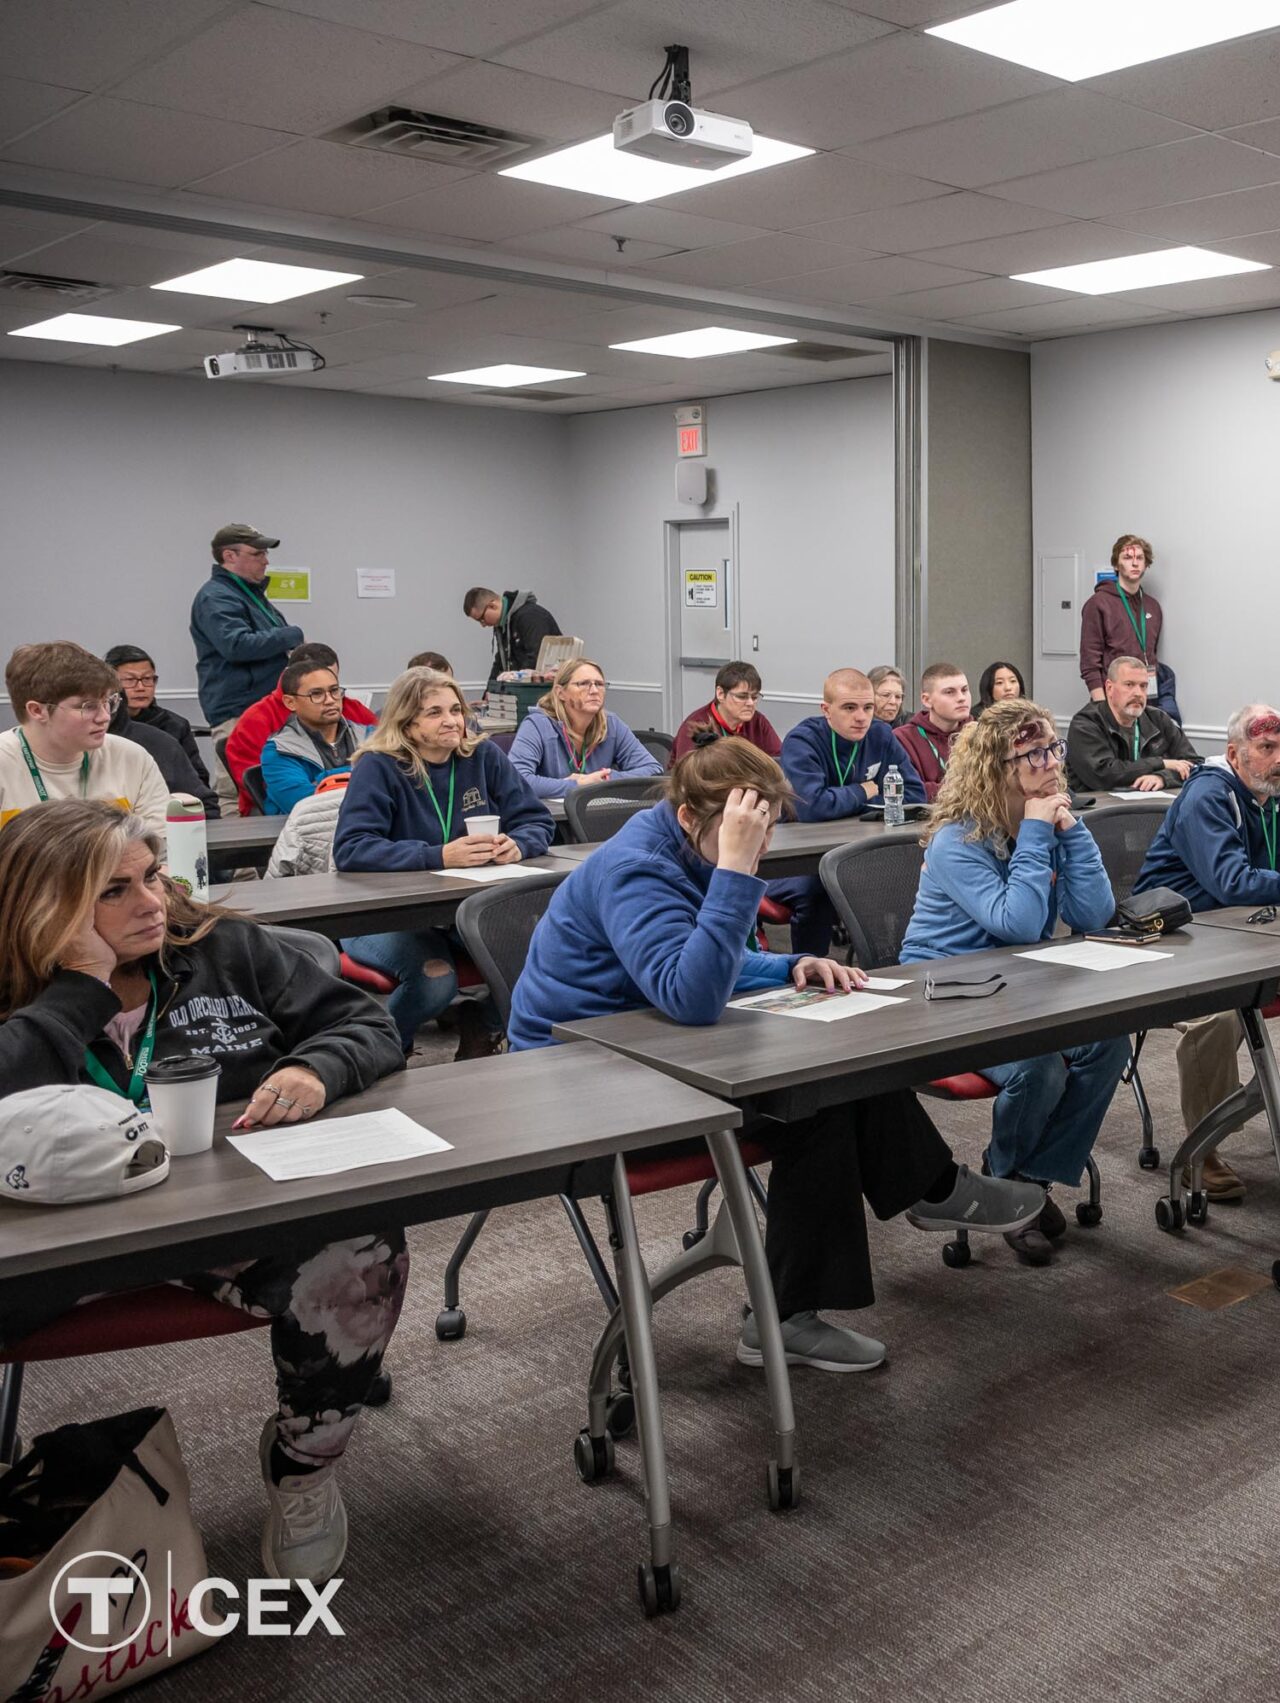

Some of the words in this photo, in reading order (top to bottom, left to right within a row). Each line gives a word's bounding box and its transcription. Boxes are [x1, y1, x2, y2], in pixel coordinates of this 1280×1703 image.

[680, 430, 698, 452] EXIT
[689, 573, 713, 581] CAUTION
[169, 1005, 189, 1027] OLD
[188, 996, 229, 1022] ORCHARD
[190, 1038, 263, 1055] MAINE
